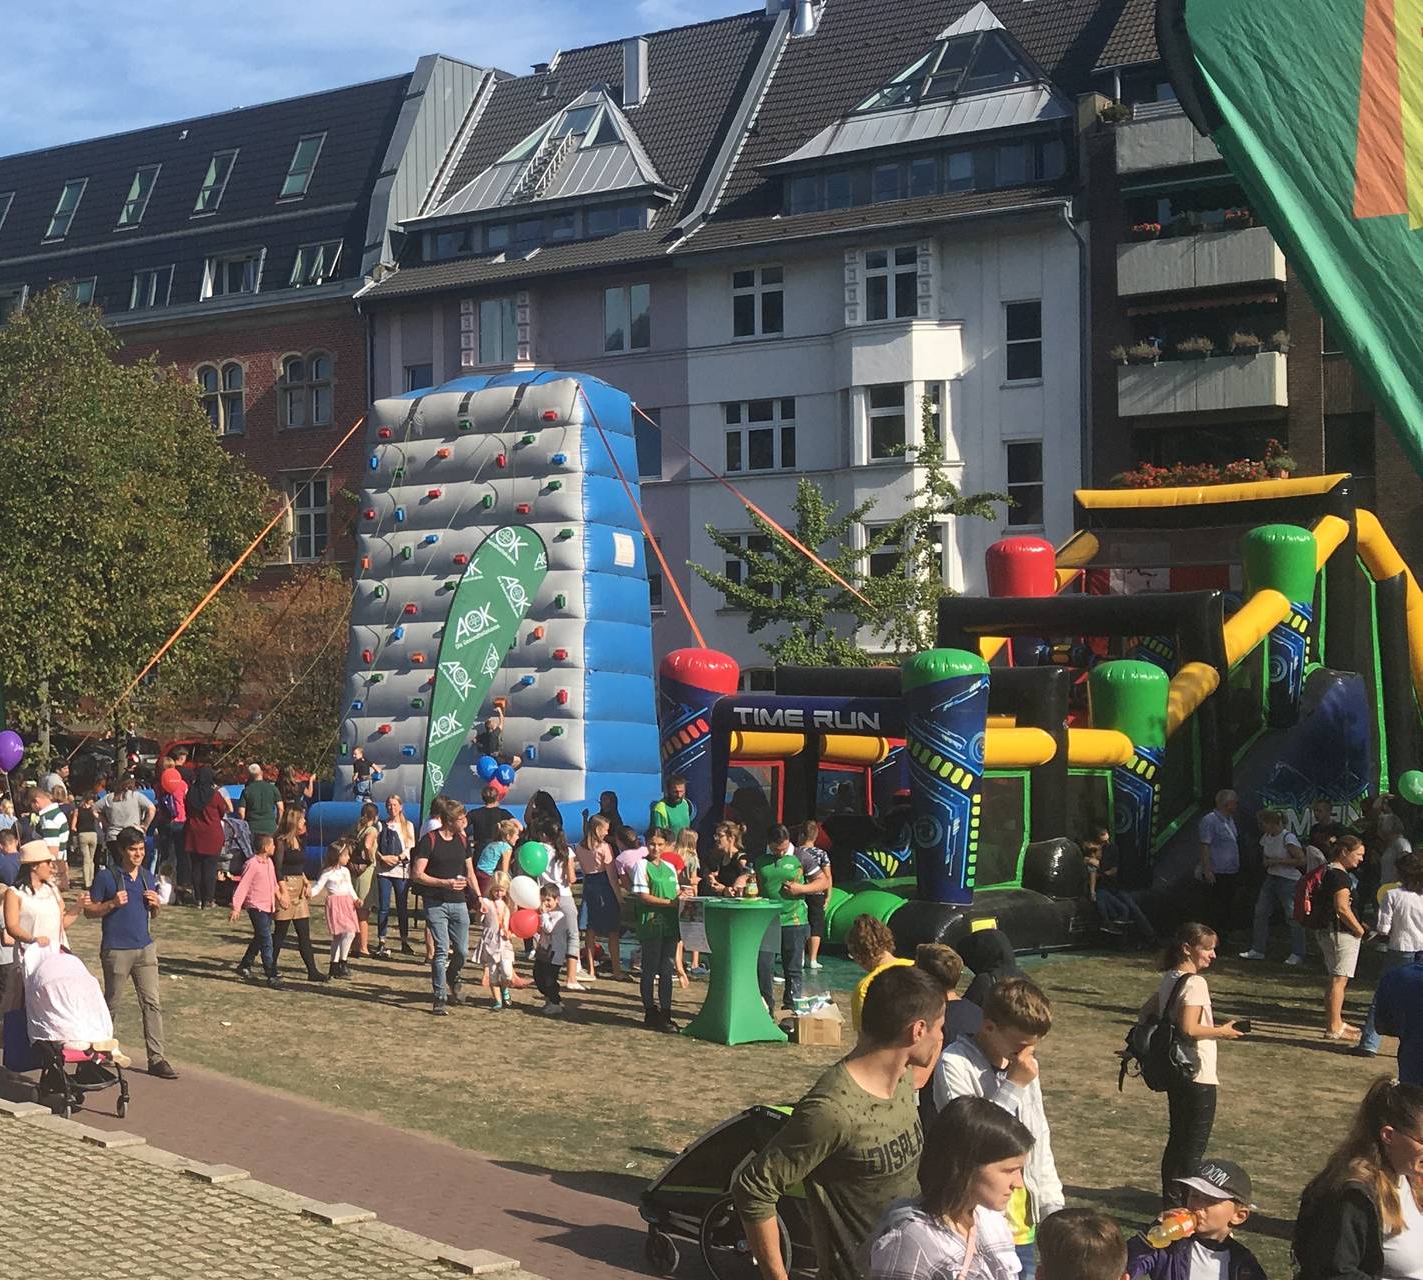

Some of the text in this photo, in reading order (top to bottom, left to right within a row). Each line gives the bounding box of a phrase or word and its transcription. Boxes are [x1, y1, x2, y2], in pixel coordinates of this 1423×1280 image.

[491, 526, 528, 560] OK
[499, 576, 532, 615] AOK
[455, 601, 498, 643] AOK
[482, 645, 500, 679] AOK
[442, 661, 477, 698] AOK
[428, 710, 462, 742] AOK
[733, 707, 881, 730] TIME RUN
[427, 761, 444, 787] AOK
